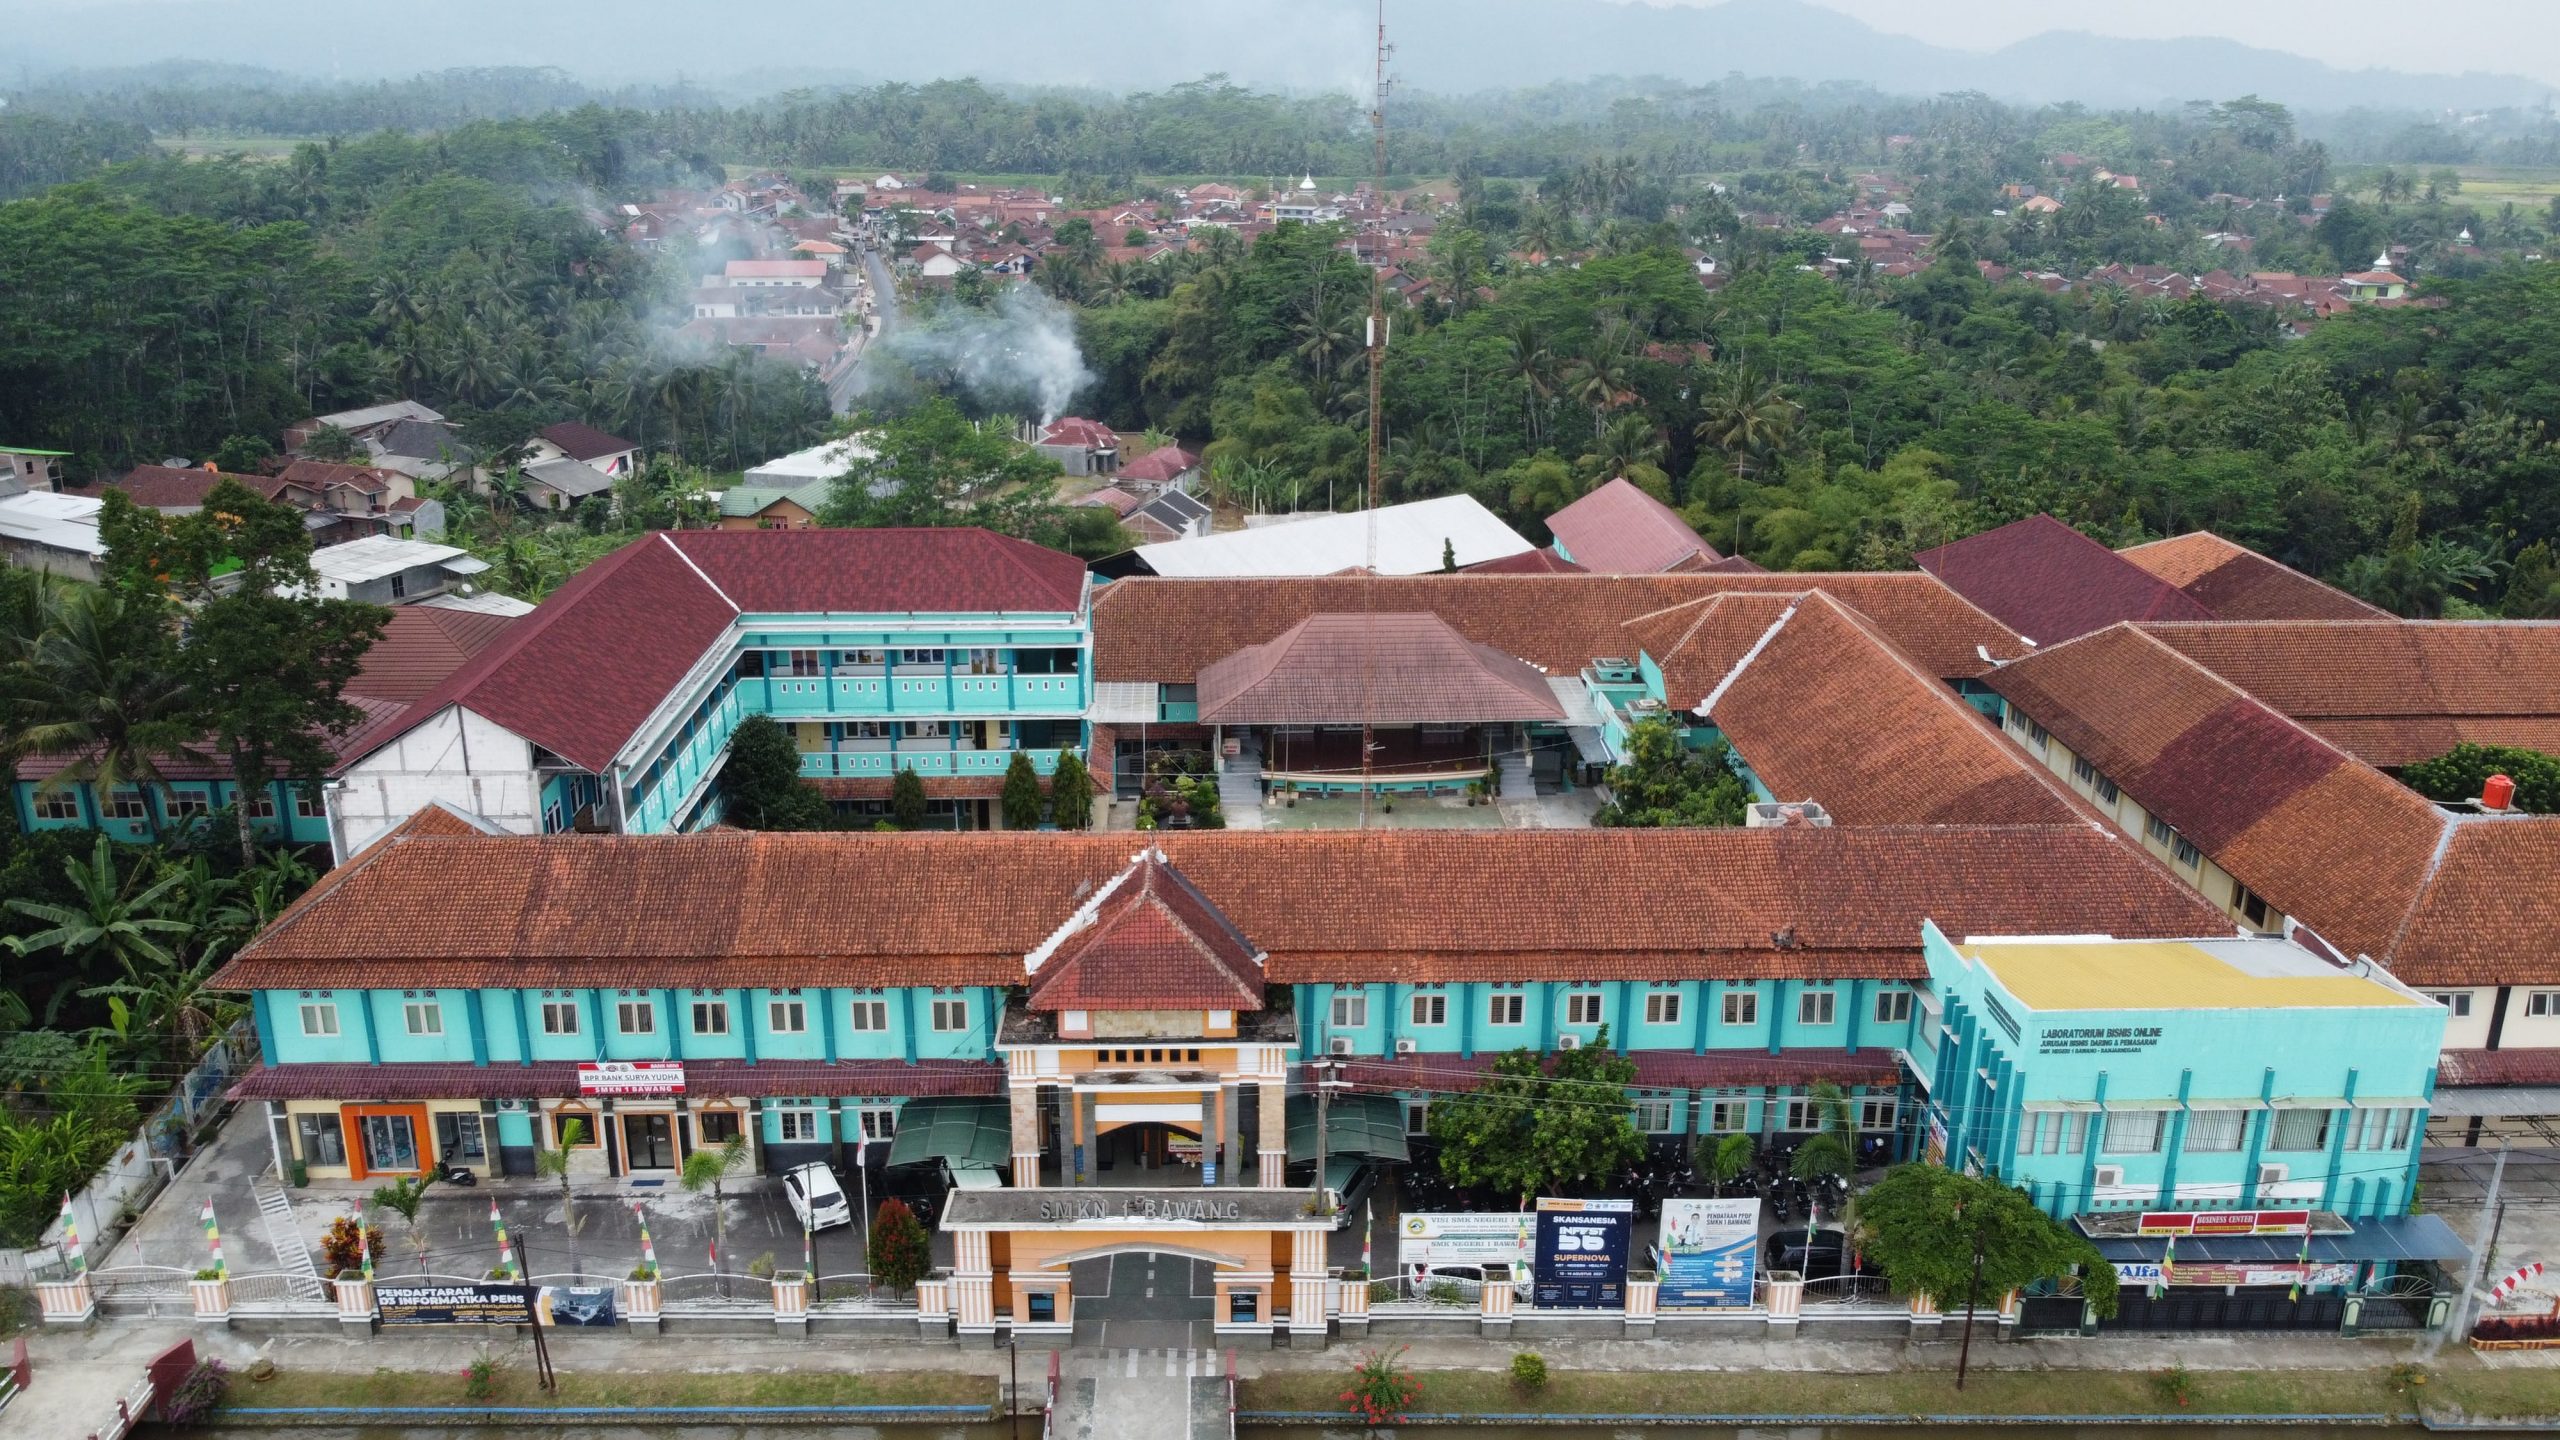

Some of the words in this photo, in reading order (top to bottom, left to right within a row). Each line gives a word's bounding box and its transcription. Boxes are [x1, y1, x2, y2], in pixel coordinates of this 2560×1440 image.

[2041, 1029, 2104, 1038] LABORATORIUM
[2106, 1028, 2131, 1038] BISNIS
[2134, 1027, 2163, 1037] ONLINE
[1040, 1201, 1106, 1220] SMKN
[1122, 1201, 1129, 1219] 1
[1145, 1200, 1239, 1219] BAWANG
[1553, 1216, 1617, 1224] SKANSANESIA
[2197, 1216, 2227, 1224] BUSINESS
[2228, 1215, 2253, 1223] CENTER
[1554, 1254, 1611, 1262] SUPERNOVA
[2120, 1265, 2159, 1277] Alfa
[376, 1287, 474, 1297] PENDAFTARAN
[378, 1297, 396, 1305] D3
[399, 1295, 488, 1305] INFORMATIKA
[491, 1295, 525, 1303] PENS
